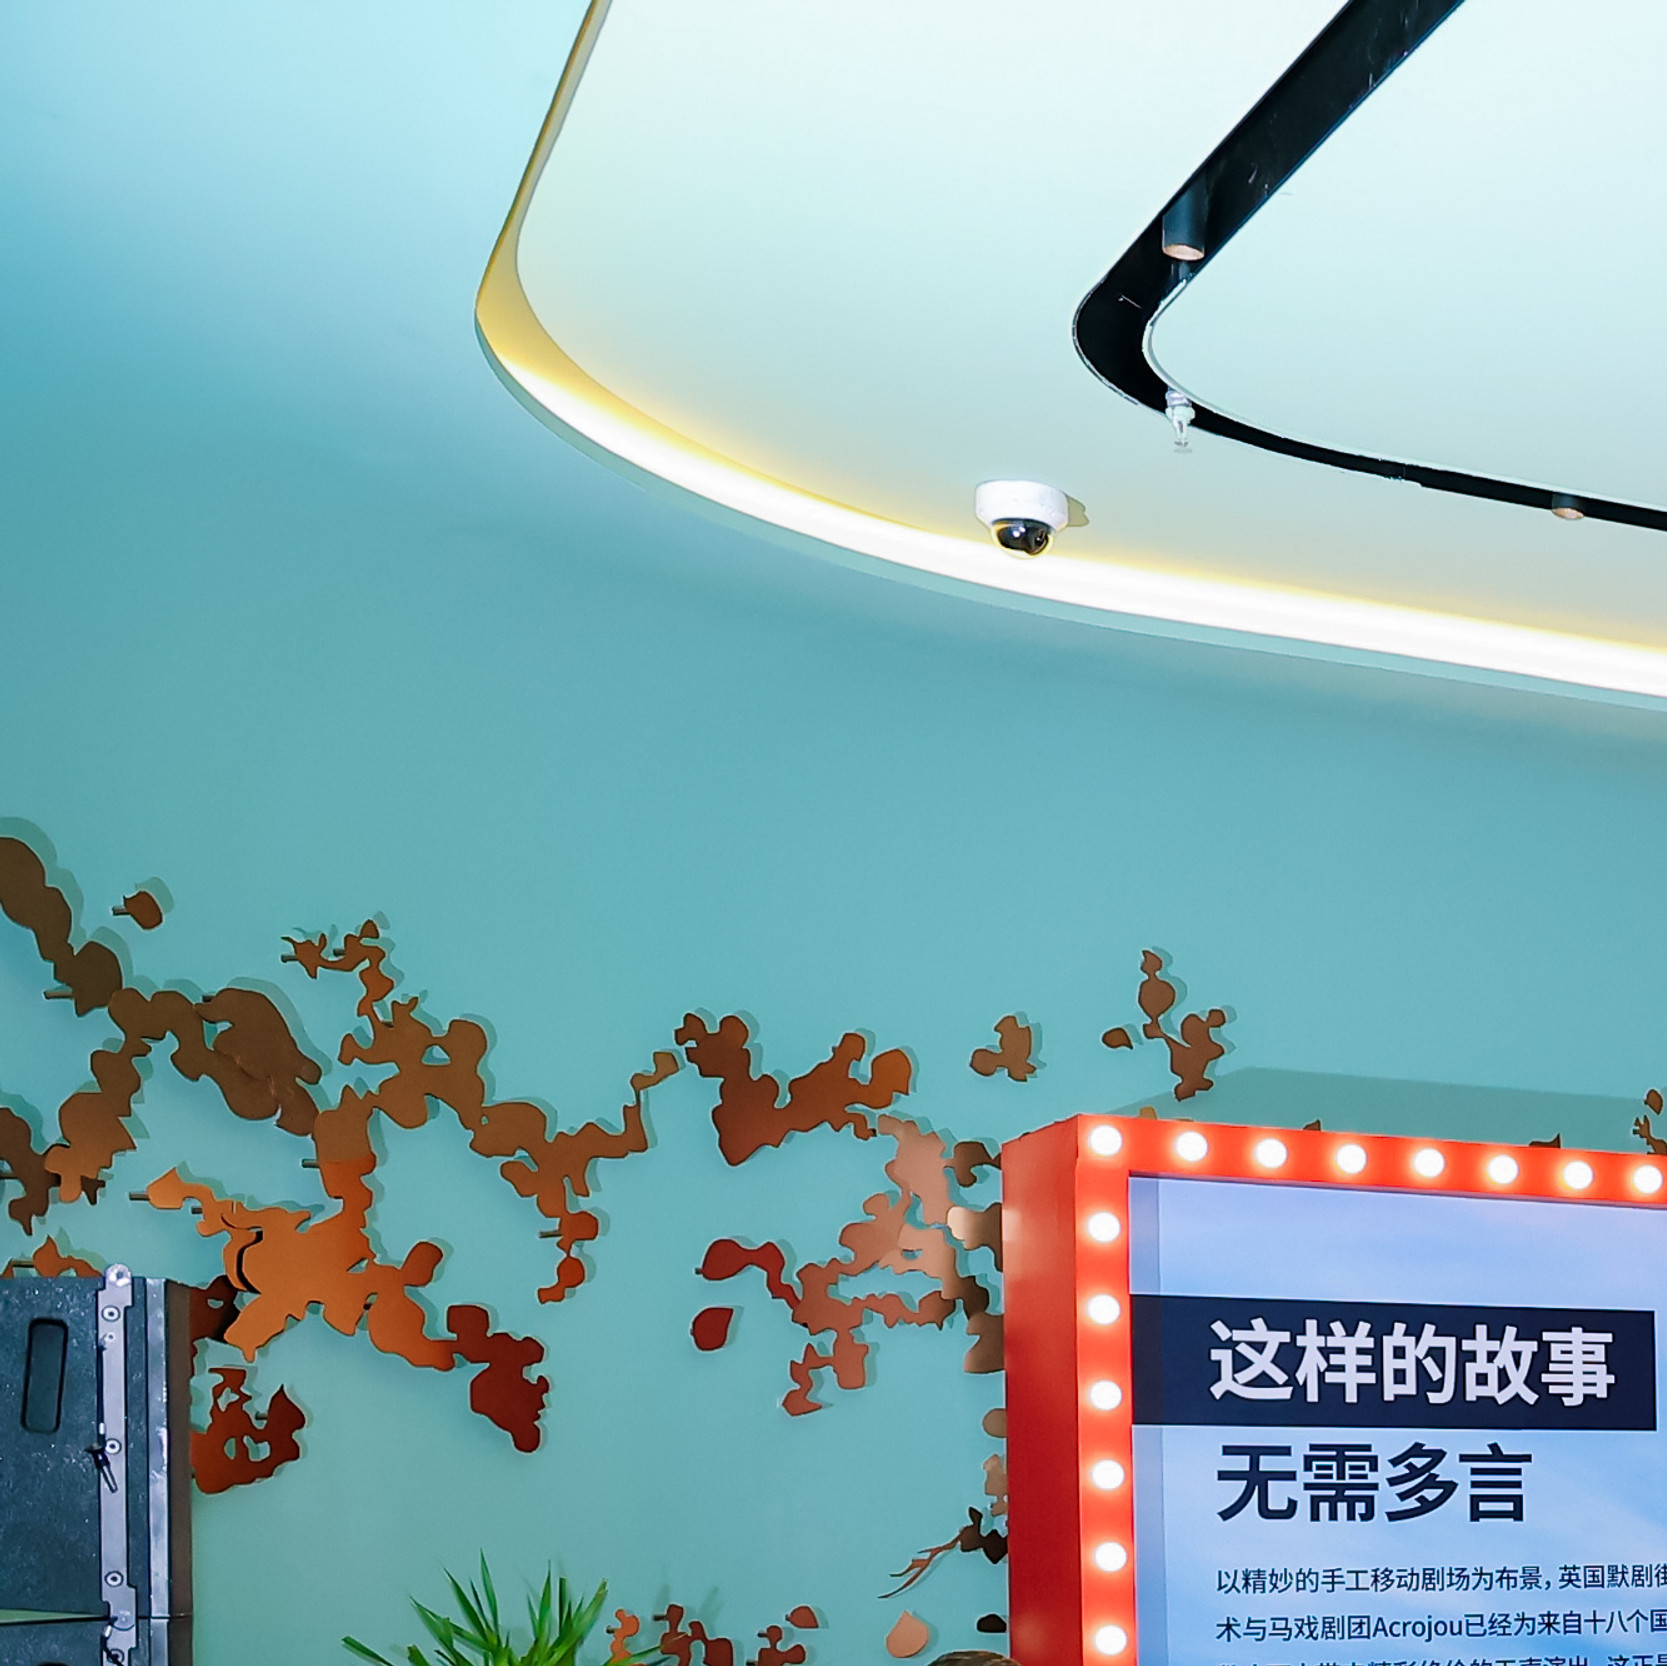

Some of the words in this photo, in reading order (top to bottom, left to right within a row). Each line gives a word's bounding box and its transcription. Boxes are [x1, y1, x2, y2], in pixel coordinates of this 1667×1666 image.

[1209, 1318, 1616, 1408] 这样的故事
[1216, 1441, 1533, 1523] 无需多言
